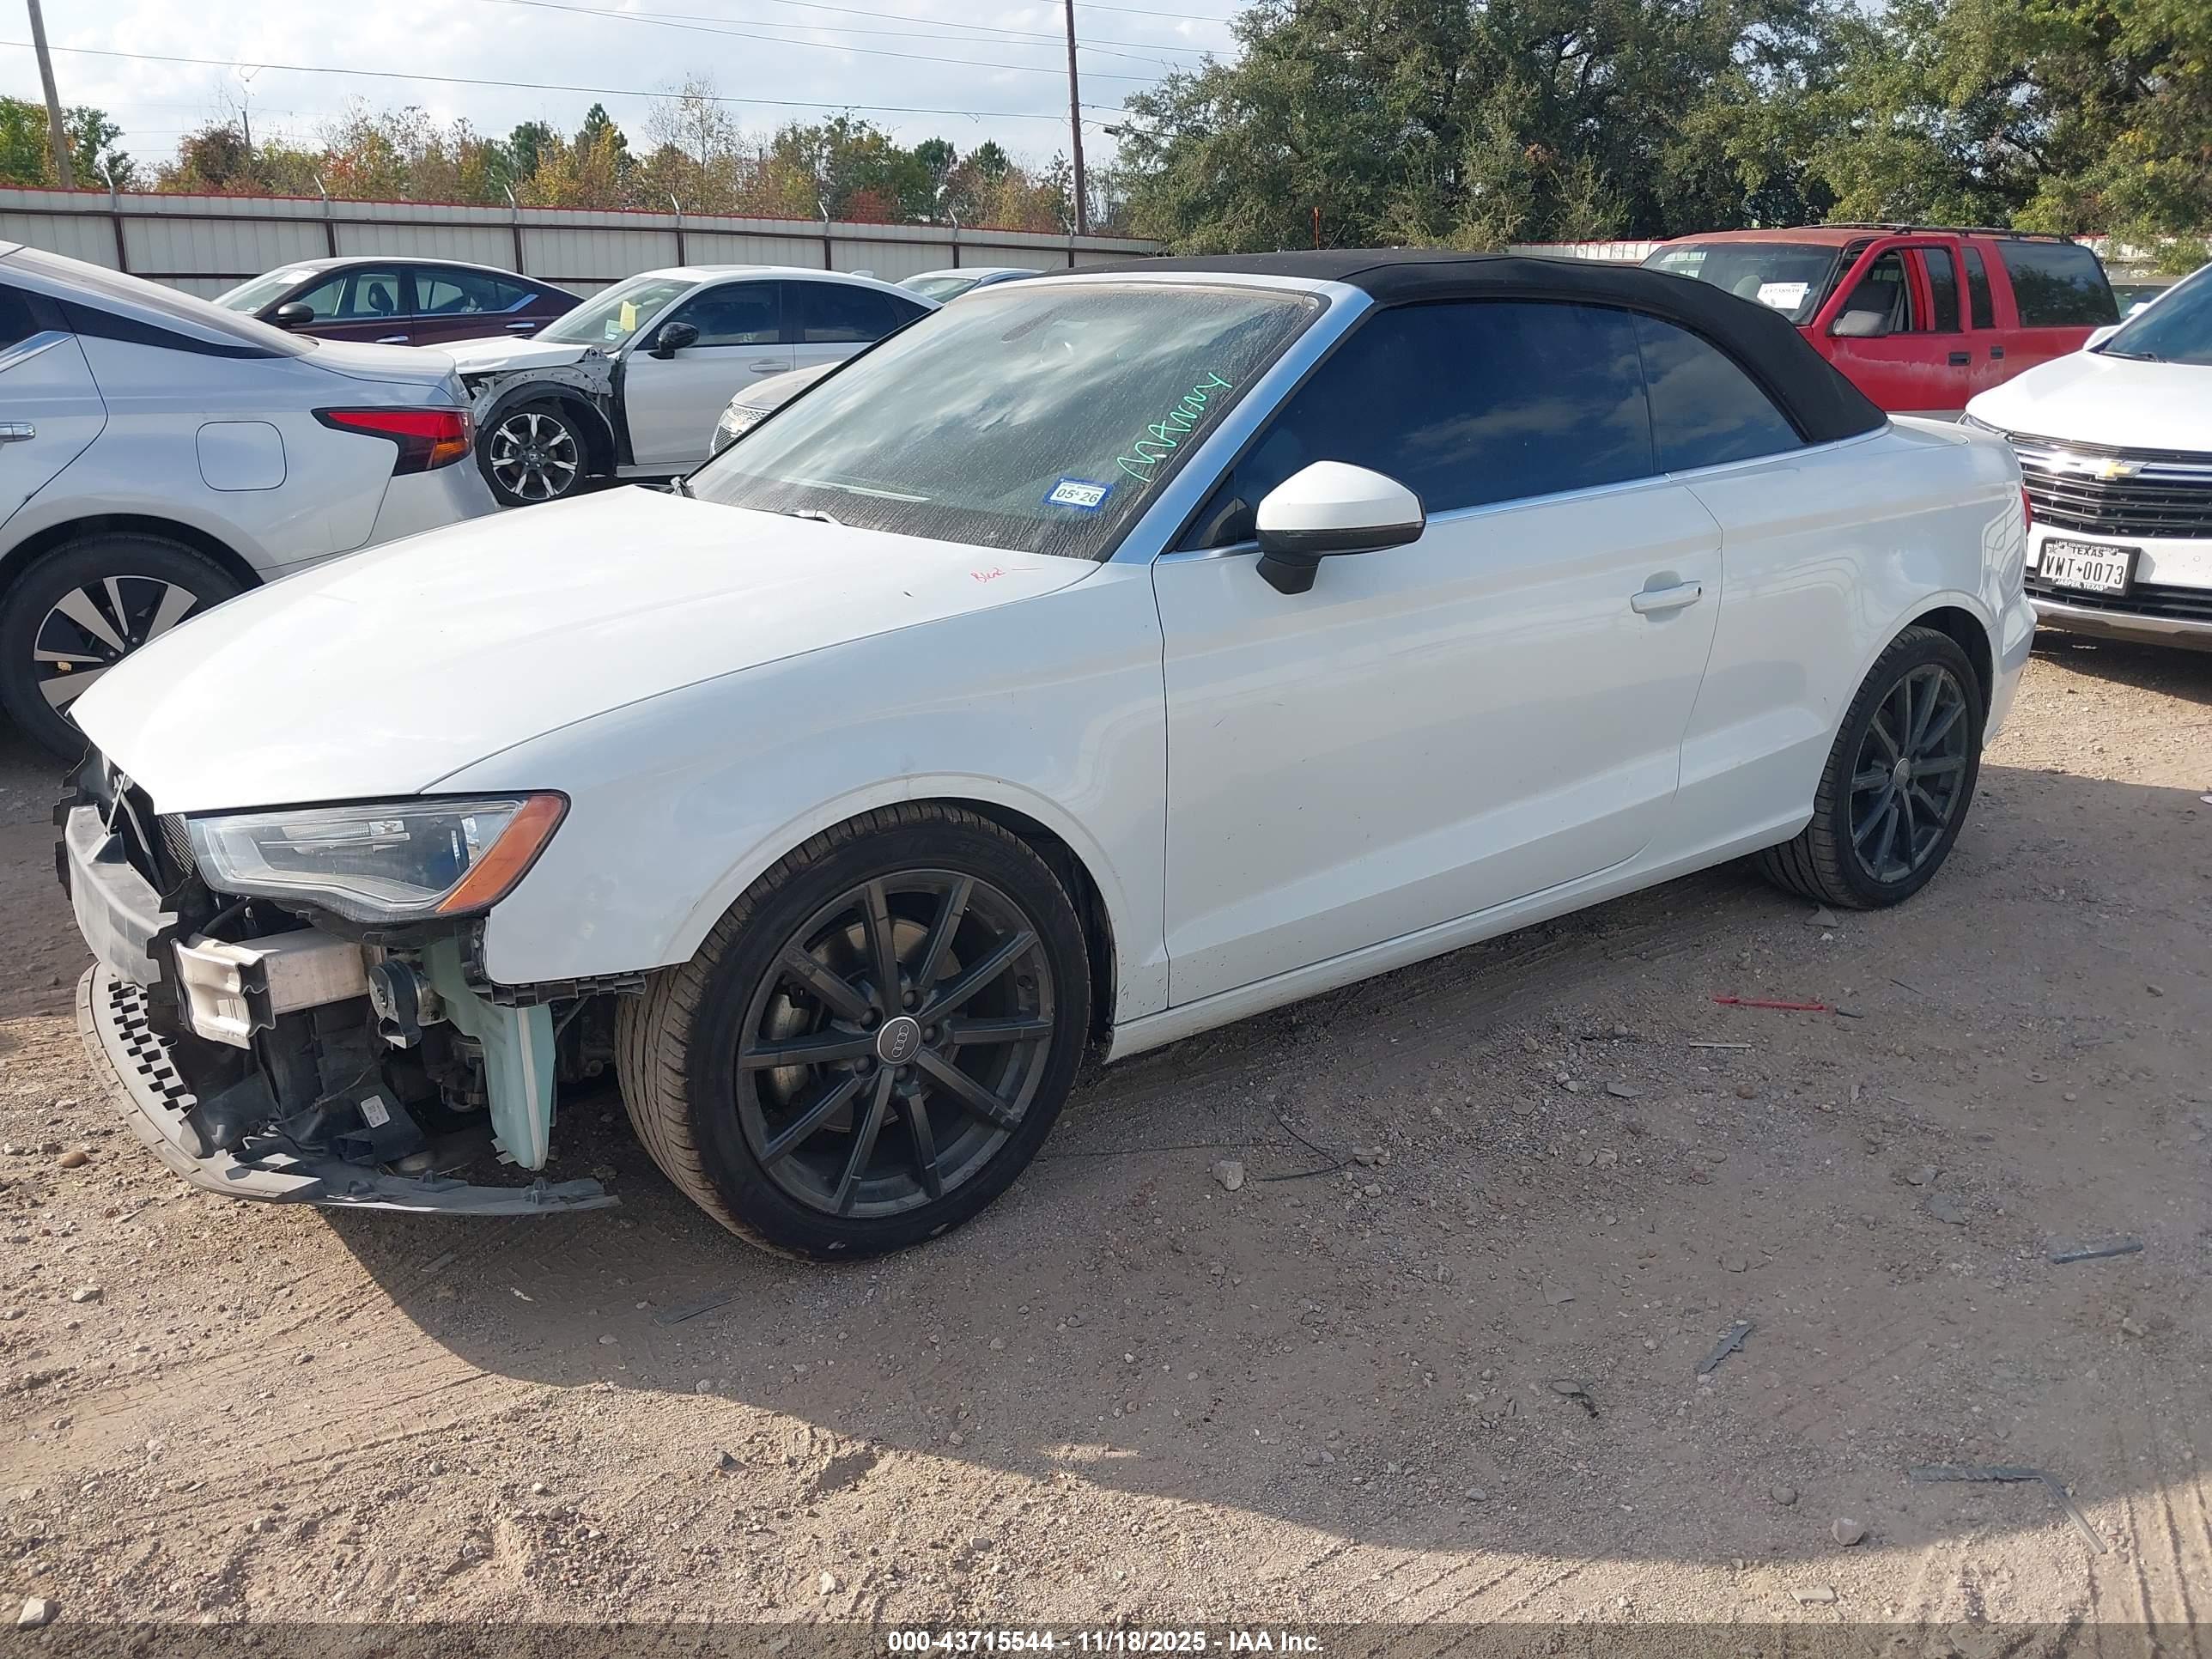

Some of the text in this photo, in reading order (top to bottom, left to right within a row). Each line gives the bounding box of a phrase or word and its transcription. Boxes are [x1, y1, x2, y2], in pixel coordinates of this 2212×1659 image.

[1116, 372, 1233, 482] MANNY
[1056, 489, 1100, 503] 05 26
[2072, 549, 2104, 558] TEXAS
[2083, 561, 2124, 585] 0073
